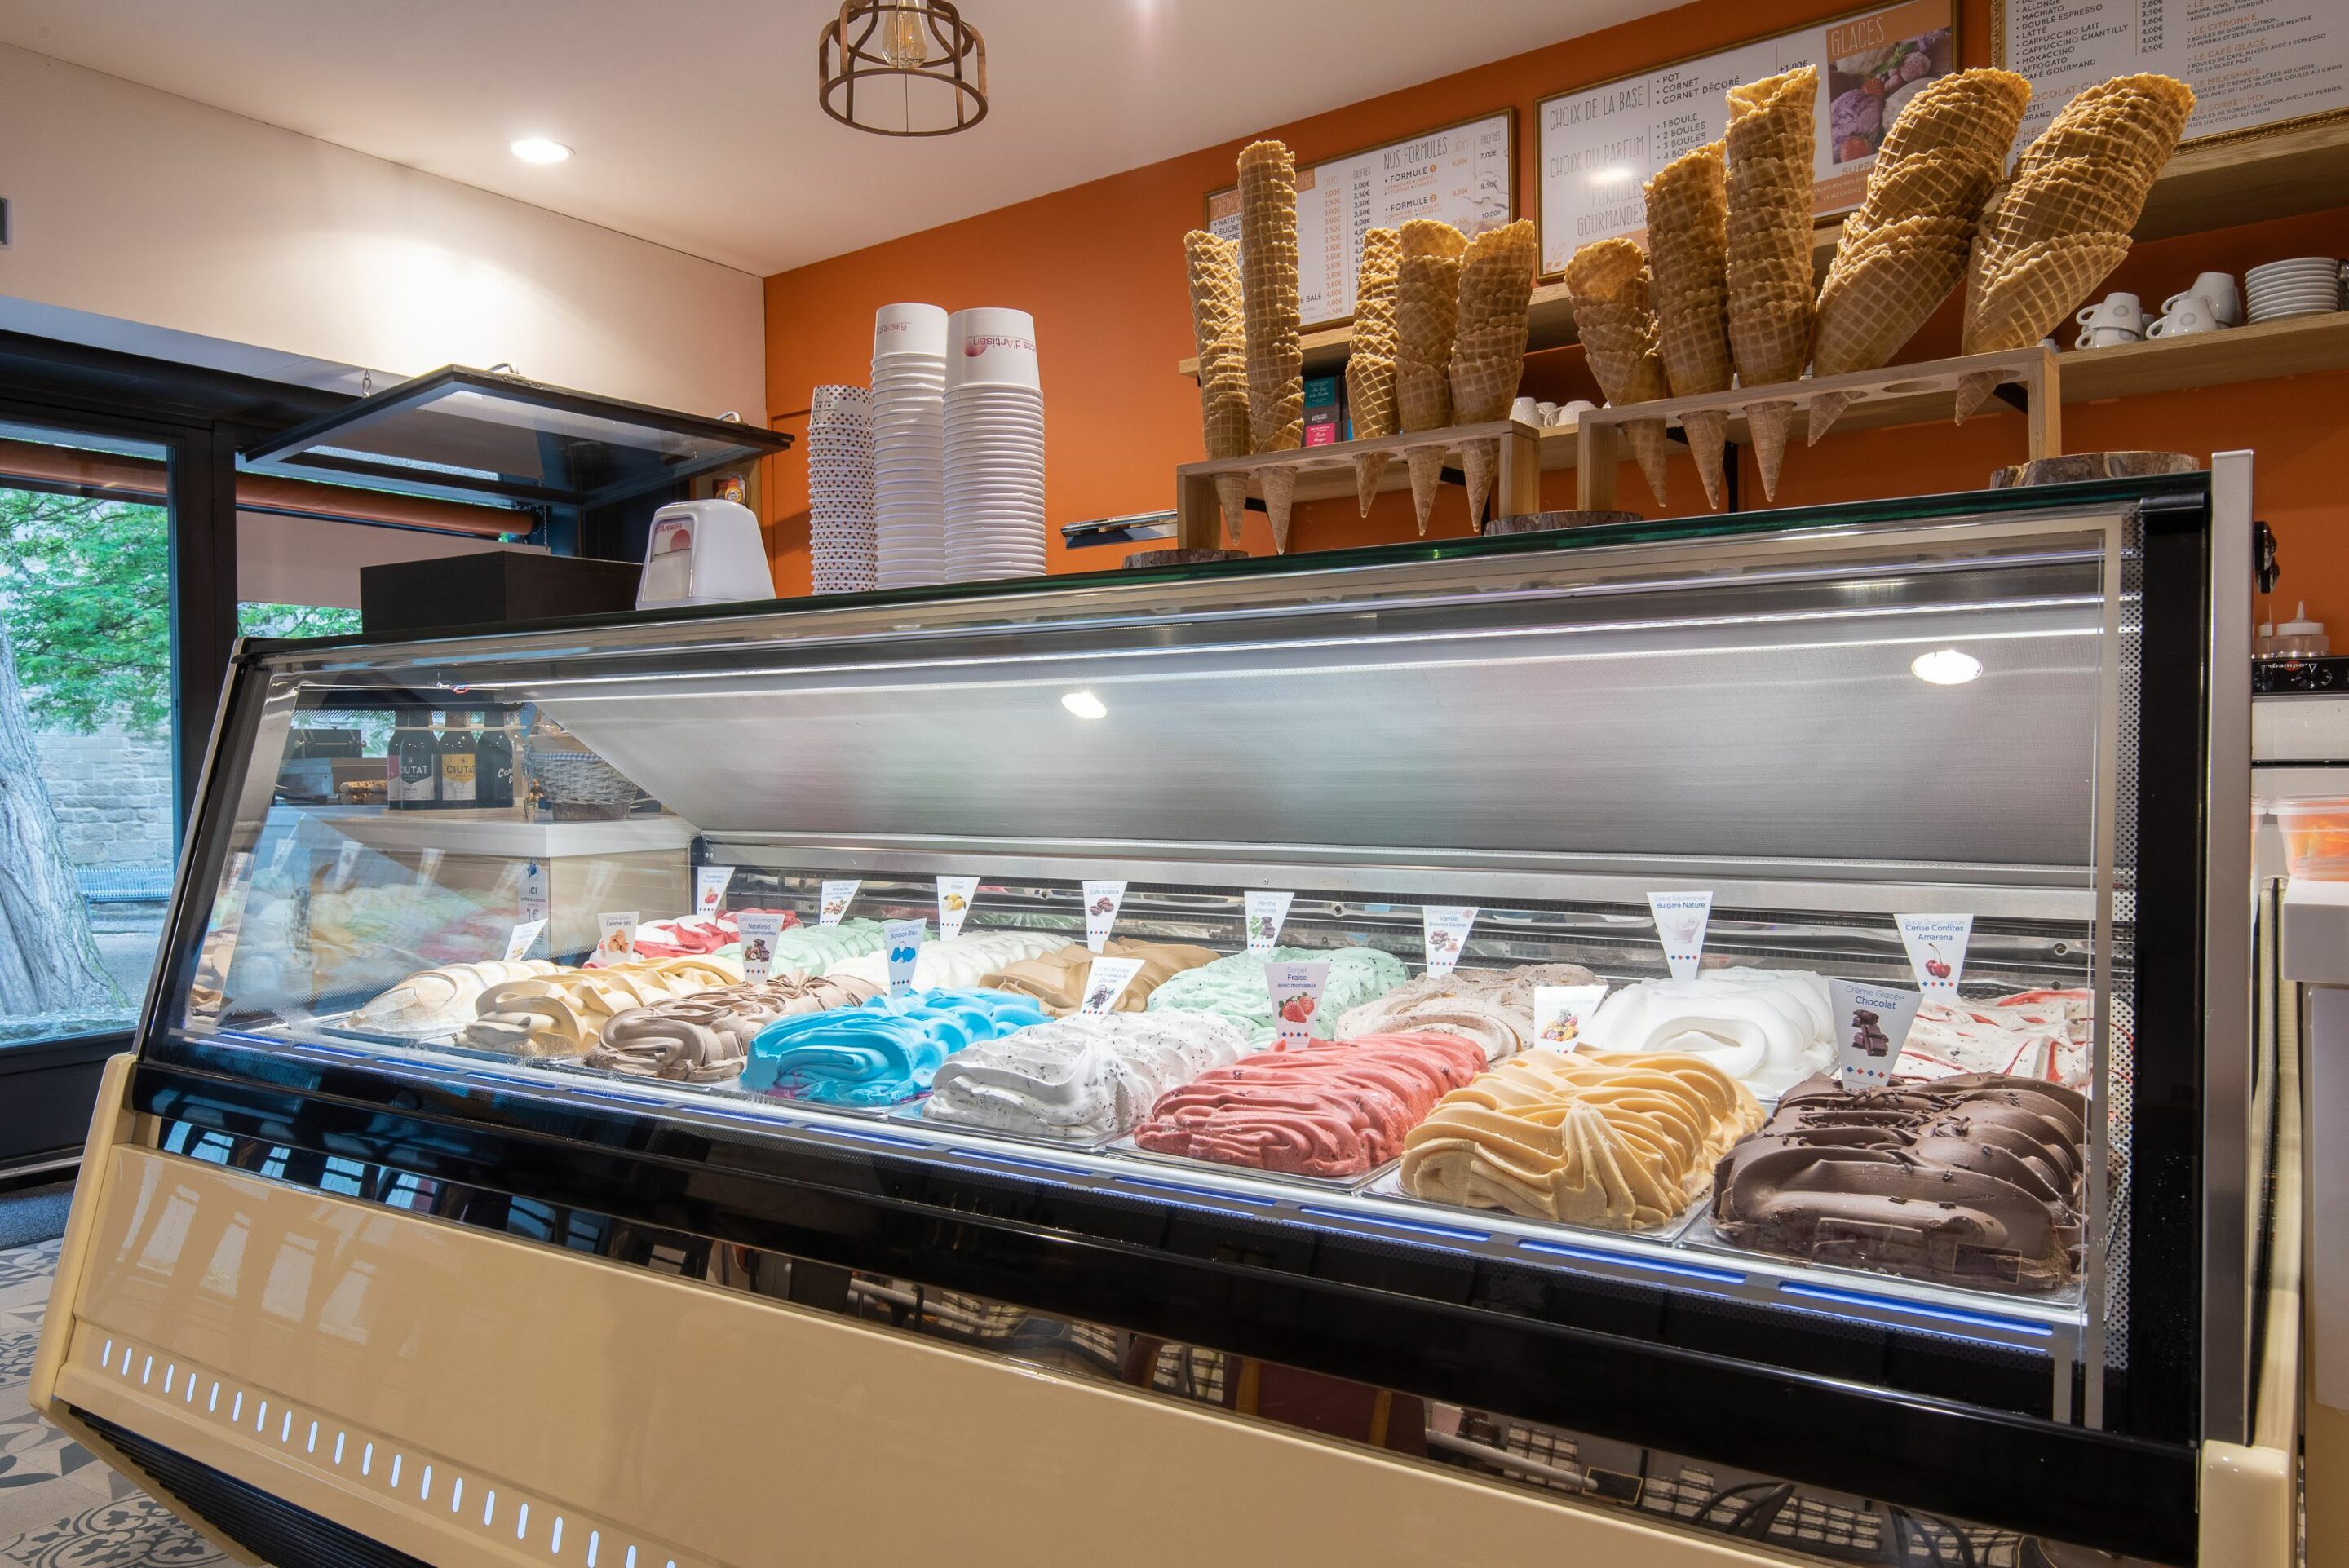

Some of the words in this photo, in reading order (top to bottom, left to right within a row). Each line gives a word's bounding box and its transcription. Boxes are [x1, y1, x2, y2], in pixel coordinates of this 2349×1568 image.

[2023, 5, 2064, 20] MACHIATO
[2023, 16, 2055, 30] DOUBLE
[2059, 4, 2103, 20] ESPRESSO
[2142, 7, 2163, 17] 3,50€
[2191, 12, 2210, 21] BOULE
[2212, 7, 2236, 16] SORBET
[2142, 15, 2163, 26] 3,80€
[1831, 17, 1884, 56] GLACES
[2023, 28, 2078, 47] CAPPUCCINO
[2081, 22, 2100, 32] LAIT
[2142, 24, 2163, 35] 4,00€
[2192, 31, 2216, 42] BOULES
[2227, 24, 2251, 33] SORBET
[2194, 26, 2205, 34] LE
[2197, 37, 2221, 46] PERRIER
[2246, 23, 2275, 35] FEUILLES
[2286, 15, 2312, 25] MENTHE
[2023, 37, 2078, 55] CAPPUCCINO
[2081, 24, 2129, 41] CHANTILLY
[2142, 33, 2163, 44] 4,00€
[2023, 46, 2075, 64] MOKACCINO
[2142, 43, 2163, 53] 6,50€
[2192, 58, 2216, 68] BOULES
[2271, 42, 2287, 51] AVEC
[2293, 33, 2326, 46] ESPRESSO
[2194, 52, 2205, 61] LE
[2207, 46, 2232, 58] CAFÉ
[2023, 56, 2068, 73] AFFOGATO
[2046, 59, 2096, 76] GOURMAND
[2214, 60, 2234, 69] GLACE
[1663, 73, 1680, 83] POT
[2208, 67, 2261, 85] MILKSHAKE
[2210, 89, 2227, 97] AVEC
[2285, 72, 2309, 81] COULIS
[2321, 64, 2343, 73] CHOIX
[1663, 77, 1699, 94] CORNET
[1663, 88, 1699, 104] CORNET
[1702, 75, 1740, 95] DÉCORÉ
[1550, 103, 1581, 130] CHOIX
[1586, 99, 1598, 121] DE
[1604, 94, 1615, 116] LA
[1619, 86, 1643, 111] BASE
[2192, 112, 2216, 121] BOULES
[2227, 105, 2250, 114] SORBET
[2263, 97, 2284, 106] CHOIX
[2207, 98, 2245, 112] SORBET
[2247, 94, 2265, 103] MIX
[1669, 113, 1698, 127] BOULE
[2023, 111, 2051, 121] GRAND
[2215, 114, 2238, 123] COULIS
[2251, 107, 2271, 116] CHOIX
[1670, 121, 1706, 137] BOULES
[1671, 132, 1706, 148] BOULES
[1384, 149, 1400, 170] NOS
[1404, 136, 1448, 165] FORMULES
[1480, 150, 1497, 160] 7,00€
[1586, 147, 1599, 169] DU
[1604, 135, 1644, 165] PARFUM
[1390, 166, 1427, 183] FORMULE
[1354, 180, 1370, 190] 3,00€
[1592, 177, 1644, 207] FORMULES
[1354, 190, 1370, 199] 3,50€
[1354, 199, 1370, 208] 3,50€
[1391, 196, 1427, 212] FORMULE
[1219, 214, 1241, 227] NATURE
[1354, 208, 1370, 218] 3,50€
[1481, 210, 1502, 219] 10,00€
[1577, 202, 1645, 236] GOURMANDES
[1219, 224, 1240, 235] SUCRE
[1354, 218, 1370, 227] 4,00€
[528, 886, 537, 895] ICI
[1845, 985, 1873, 996] Crème
[1876, 989, 1904, 1001] Glacée
[1855, 996, 1897, 1011] Chocolat
